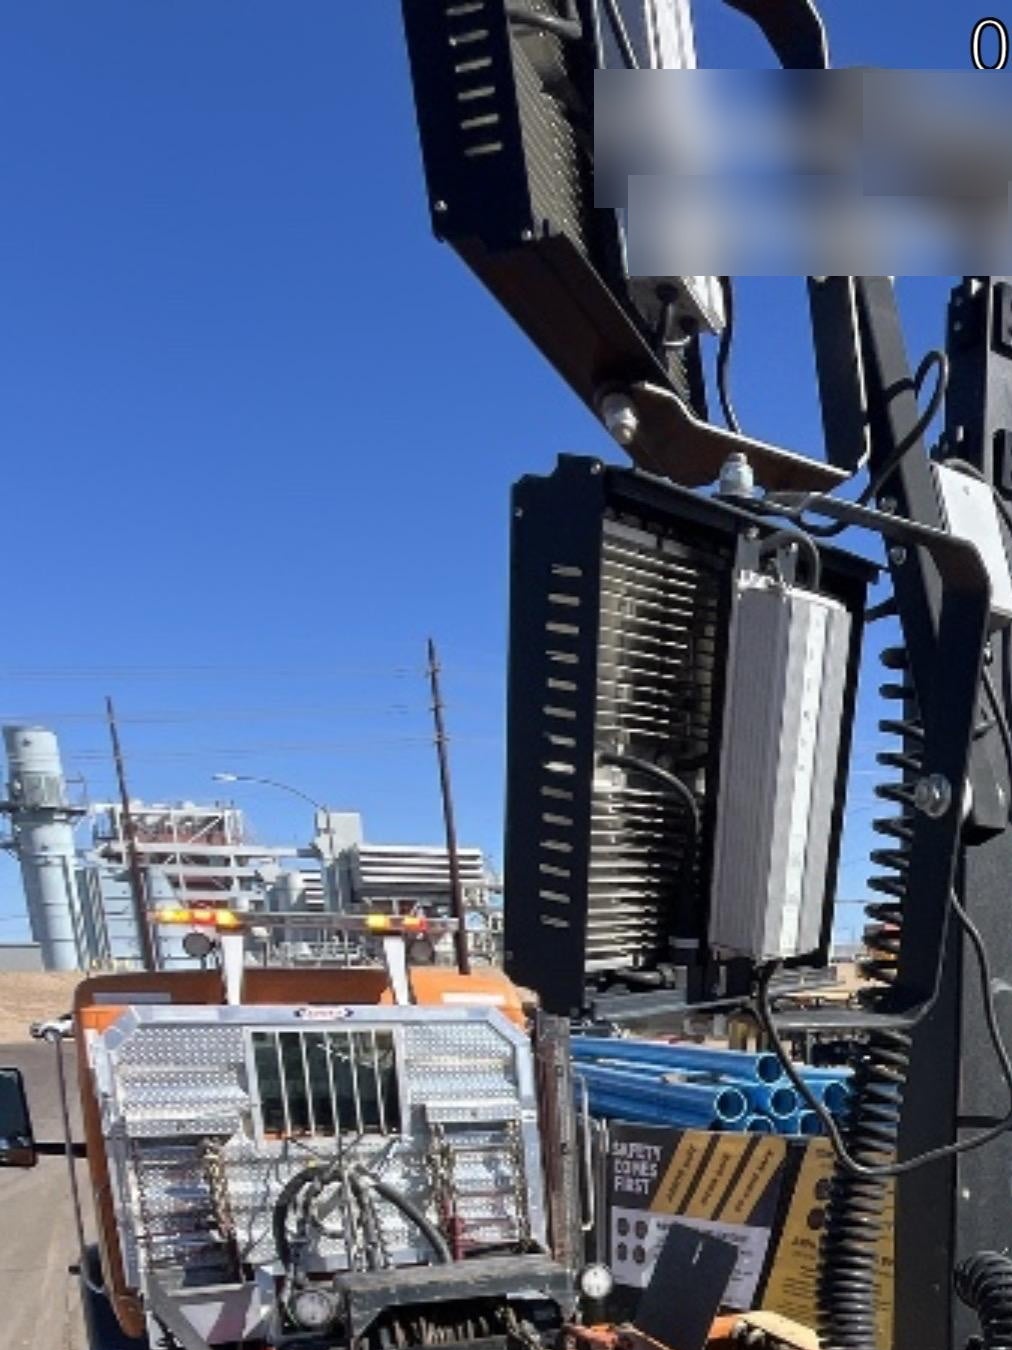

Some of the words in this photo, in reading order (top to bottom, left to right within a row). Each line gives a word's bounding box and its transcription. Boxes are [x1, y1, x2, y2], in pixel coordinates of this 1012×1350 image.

[611, 1140, 663, 1161] SAFETY
[614, 1158, 658, 1178] COMES
[614, 1175, 650, 1195] FIRST
